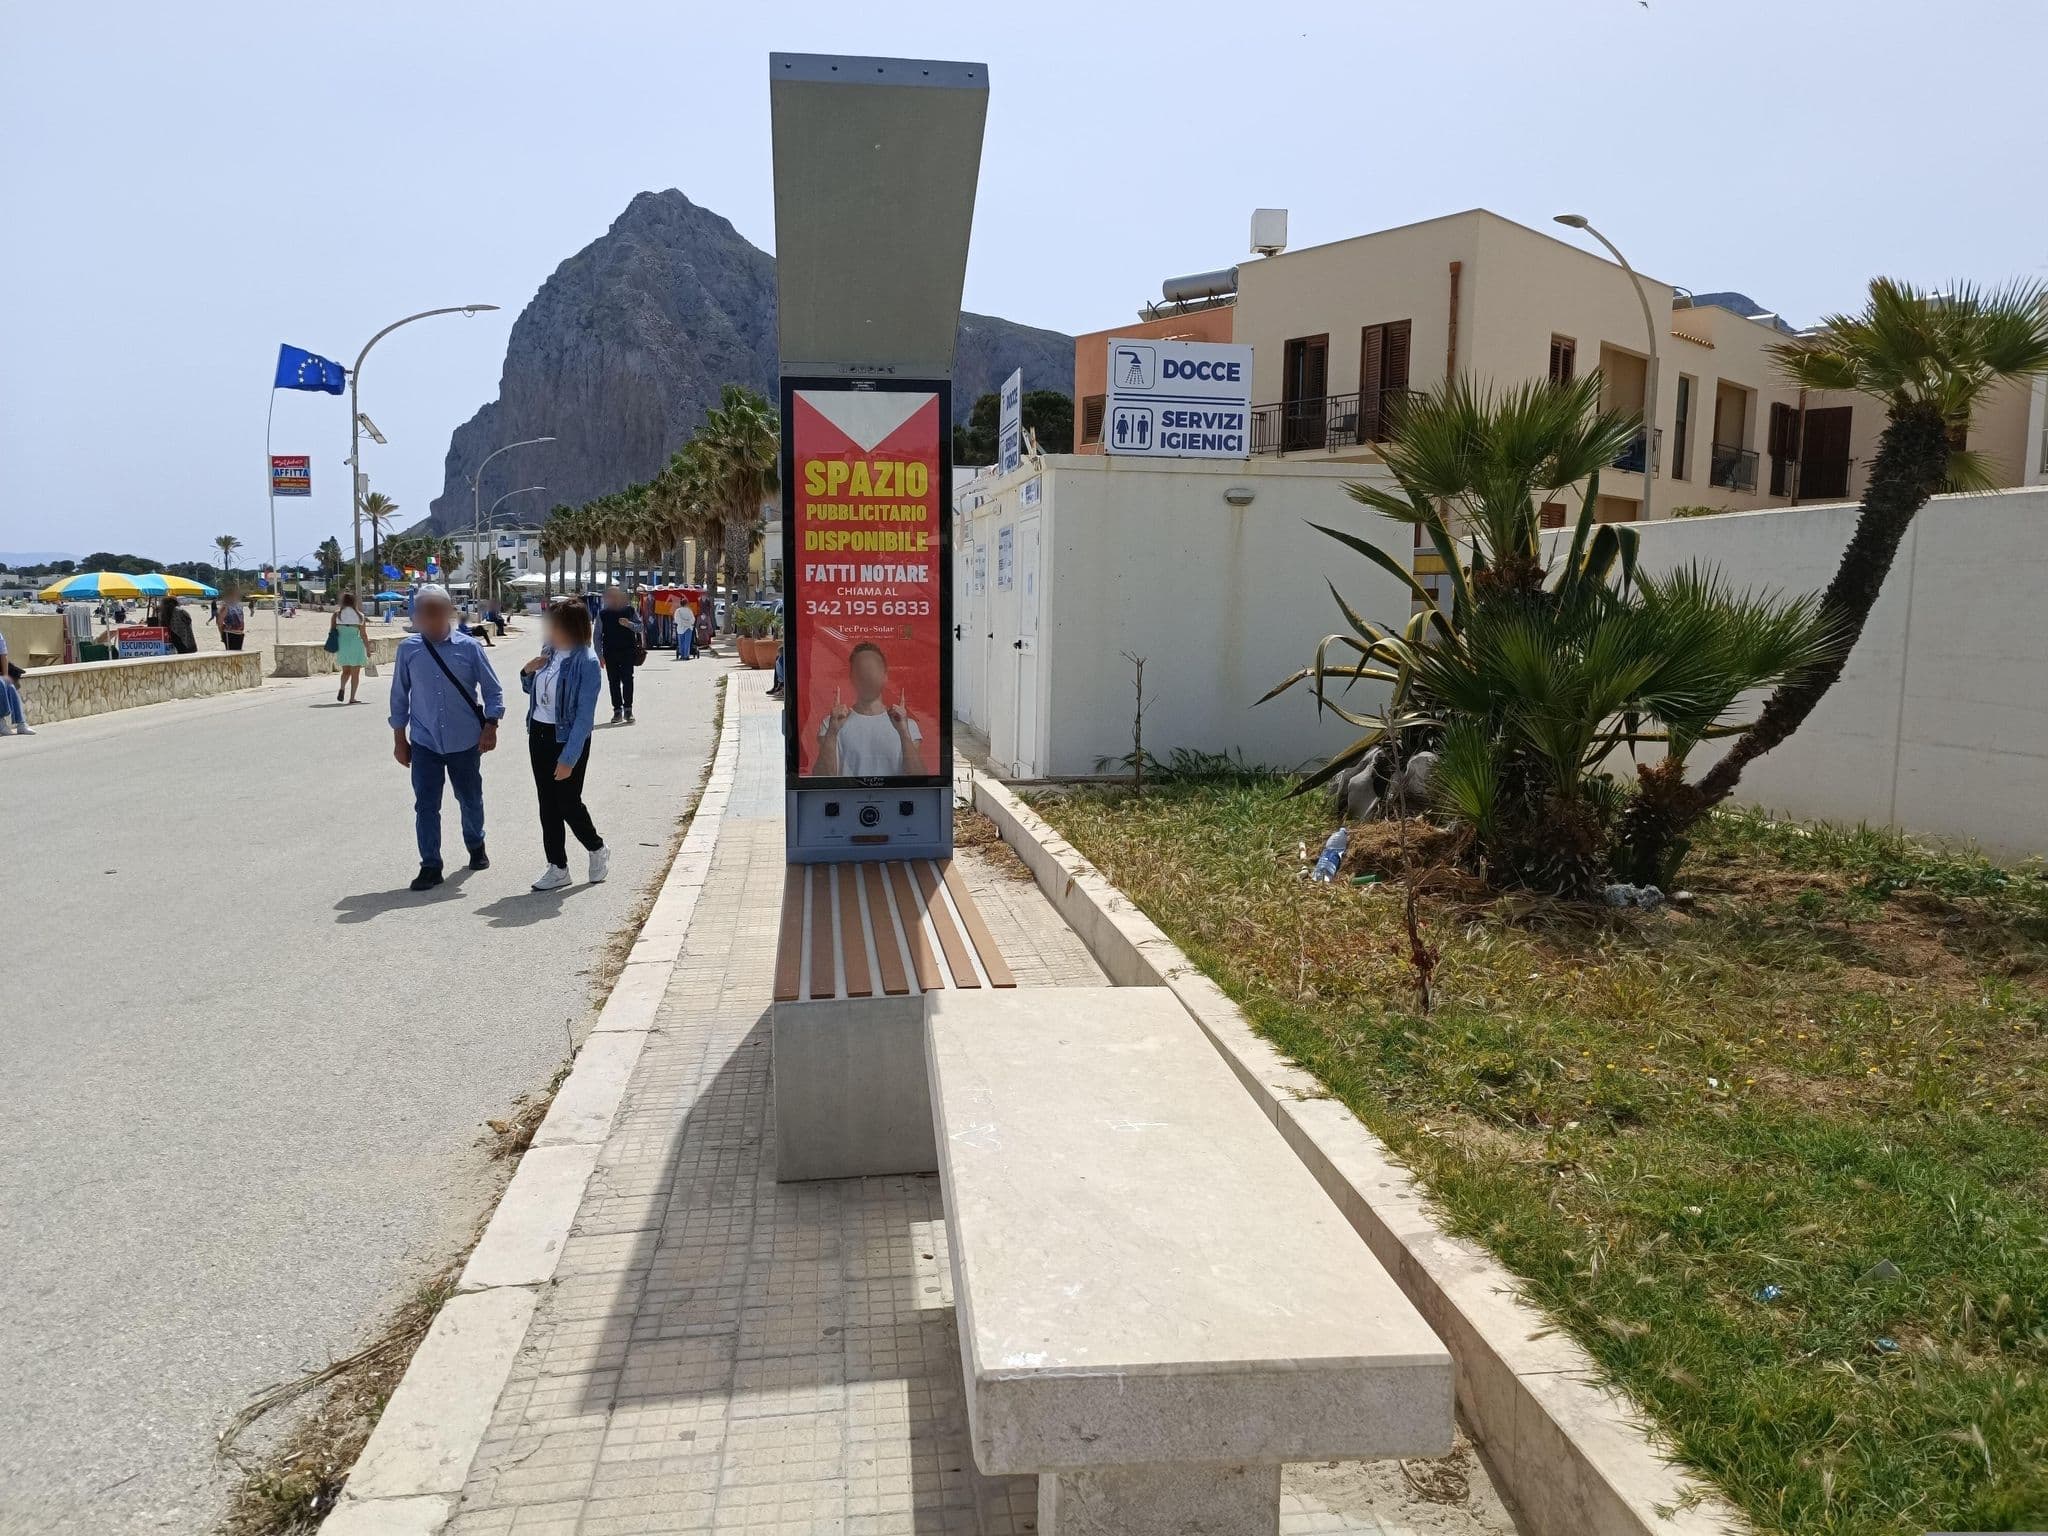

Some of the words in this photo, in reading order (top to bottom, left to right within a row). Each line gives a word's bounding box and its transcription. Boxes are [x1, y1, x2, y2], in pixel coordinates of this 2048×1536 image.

[1163, 360, 1240, 381] DOCCE
[1161, 411, 1243, 430] SERVIZI
[1160, 431, 1243, 451] IGIENICI
[274, 468, 309, 477] AFFITTA
[805, 461, 928, 497] SPAZIO
[806, 504, 928, 522] PUBBLICITARIO
[806, 531, 928, 551] DISPONIBILE
[805, 564, 855, 583] FATTI
[861, 565, 928, 583] NOTARE
[837, 587, 882, 596] CHIAMA
[884, 587, 898, 596] AL
[806, 601, 841, 616] 342
[846, 601, 877, 616] 195
[882, 601, 930, 616] 6833
[121, 641, 161, 650] ESCURSIONI
